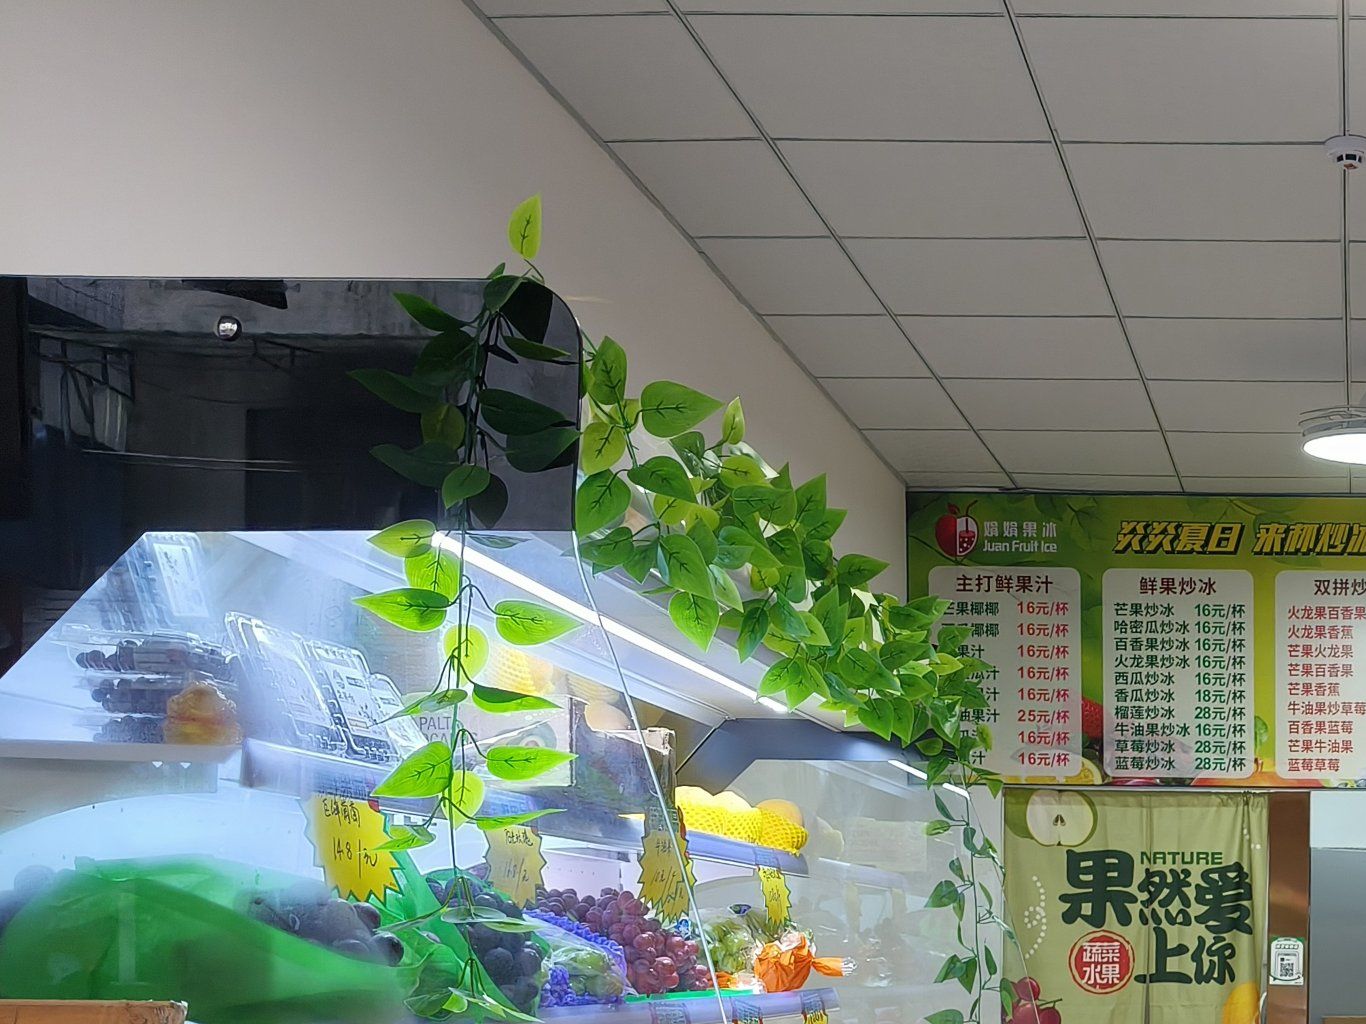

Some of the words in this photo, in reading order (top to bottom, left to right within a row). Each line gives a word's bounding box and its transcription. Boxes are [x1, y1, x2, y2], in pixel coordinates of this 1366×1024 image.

[983, 521, 1057, 537] 娟娟果冰
[1112, 520, 1245, 554] 炎炎夏日
[983, 540, 1011, 552] Juan
[1012, 540, 1039, 552] Fruit
[1040, 541, 1057, 553] Ice
[956, 574, 1053, 593] 主打鲜果汁
[1139, 577, 1217, 596] 鲜果炒冰
[1017, 601, 1069, 616] 16元/杯
[1114, 603, 1175, 617] 芒果炒冰
[1194, 604, 1246, 619] 16元/杯
[1288, 606, 1366, 620] 火龙果百香果
[1017, 623, 1069, 637] 16元/杯
[1114, 620, 1190, 634] 哈密瓜炒冰
[1194, 621, 1246, 636] 16元/杯
[1288, 626, 1353, 639] 火龙果香蕉
[1017, 644, 1069, 659] 16元/杯
[1114, 637, 1190, 651] 百香果炒冰
[1194, 638, 1246, 653] 16元/杯
[1288, 645, 1353, 658] 芒果火龙果
[1114, 655, 1190, 668] 火龙果炒冰
[1194, 655, 1246, 670] 16元/杯
[1017, 666, 1069, 681] 16元/杯
[1288, 664, 1353, 677] 芒果百香果
[1114, 672, 1175, 686] 西瓜炒冰
[1194, 672, 1246, 687] 16元/杯
[1017, 688, 1069, 702] 16元/杯
[1114, 689, 1175, 703] 香瓜炒冰
[1194, 690, 1246, 704] 18元/杯
[1288, 683, 1340, 696] 芒果香蕉
[1017, 709, 1069, 724] 25元/杯
[1114, 706, 1175, 720] 榴莲炒冰
[1194, 706, 1246, 721] 28元/杯
[1288, 702, 1366, 716] 牛油果炒草莓
[1114, 723, 1190, 737] 牛油果炒冰
[1194, 723, 1246, 738] 16元/杯
[1288, 721, 1353, 734] 百香果蓝莓
[1017, 732, 1069, 746] 16元/杯
[1288, 740, 1353, 753] 芒果牛油果
[1114, 740, 1175, 754] 草莓炒冰
[1194, 741, 1246, 755] 28元/杯
[1017, 752, 1069, 767] 16元/杯
[1114, 757, 1175, 771] 蓝莓炒冰
[1194, 757, 1246, 772] 28元/杯
[1288, 759, 1340, 772] 蓝莓草莓
[1140, 851, 1223, 865] NATURE
[1058, 849, 1254, 935] 果然爱
[1082, 942, 1120, 962] 蔬菜
[1134, 926, 1237, 986] 上你
[1082, 964, 1120, 985] 水果
